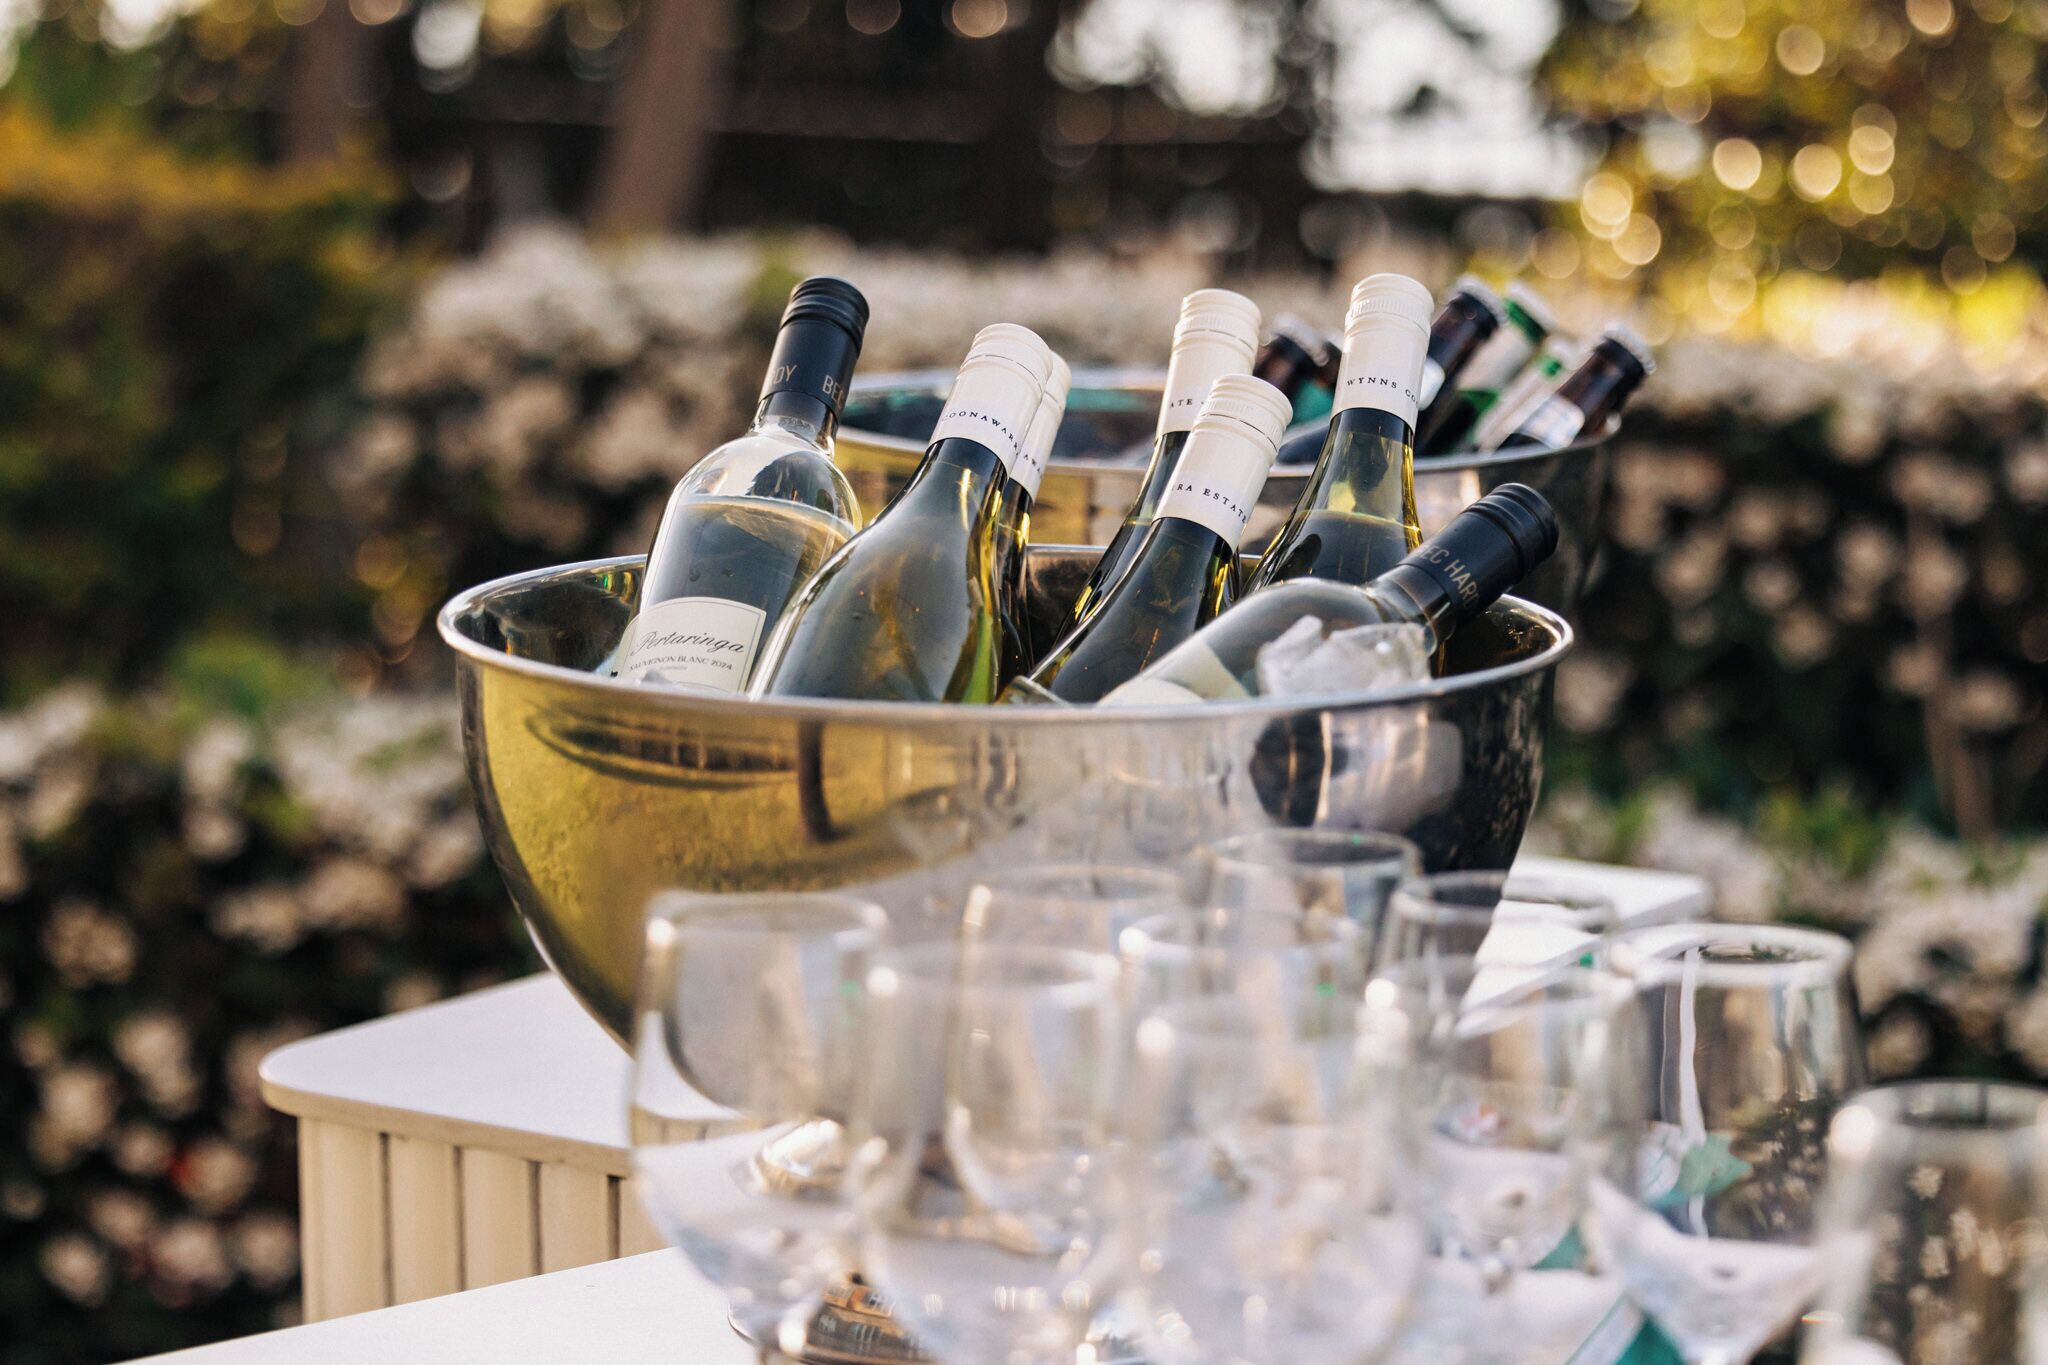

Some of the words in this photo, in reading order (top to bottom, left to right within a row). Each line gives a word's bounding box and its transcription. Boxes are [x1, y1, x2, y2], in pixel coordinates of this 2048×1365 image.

[1347, 377, 1397, 389] WYNNS
[630, 631, 745, 657] Pertaringa
[677, 655, 709, 666] BLANC
